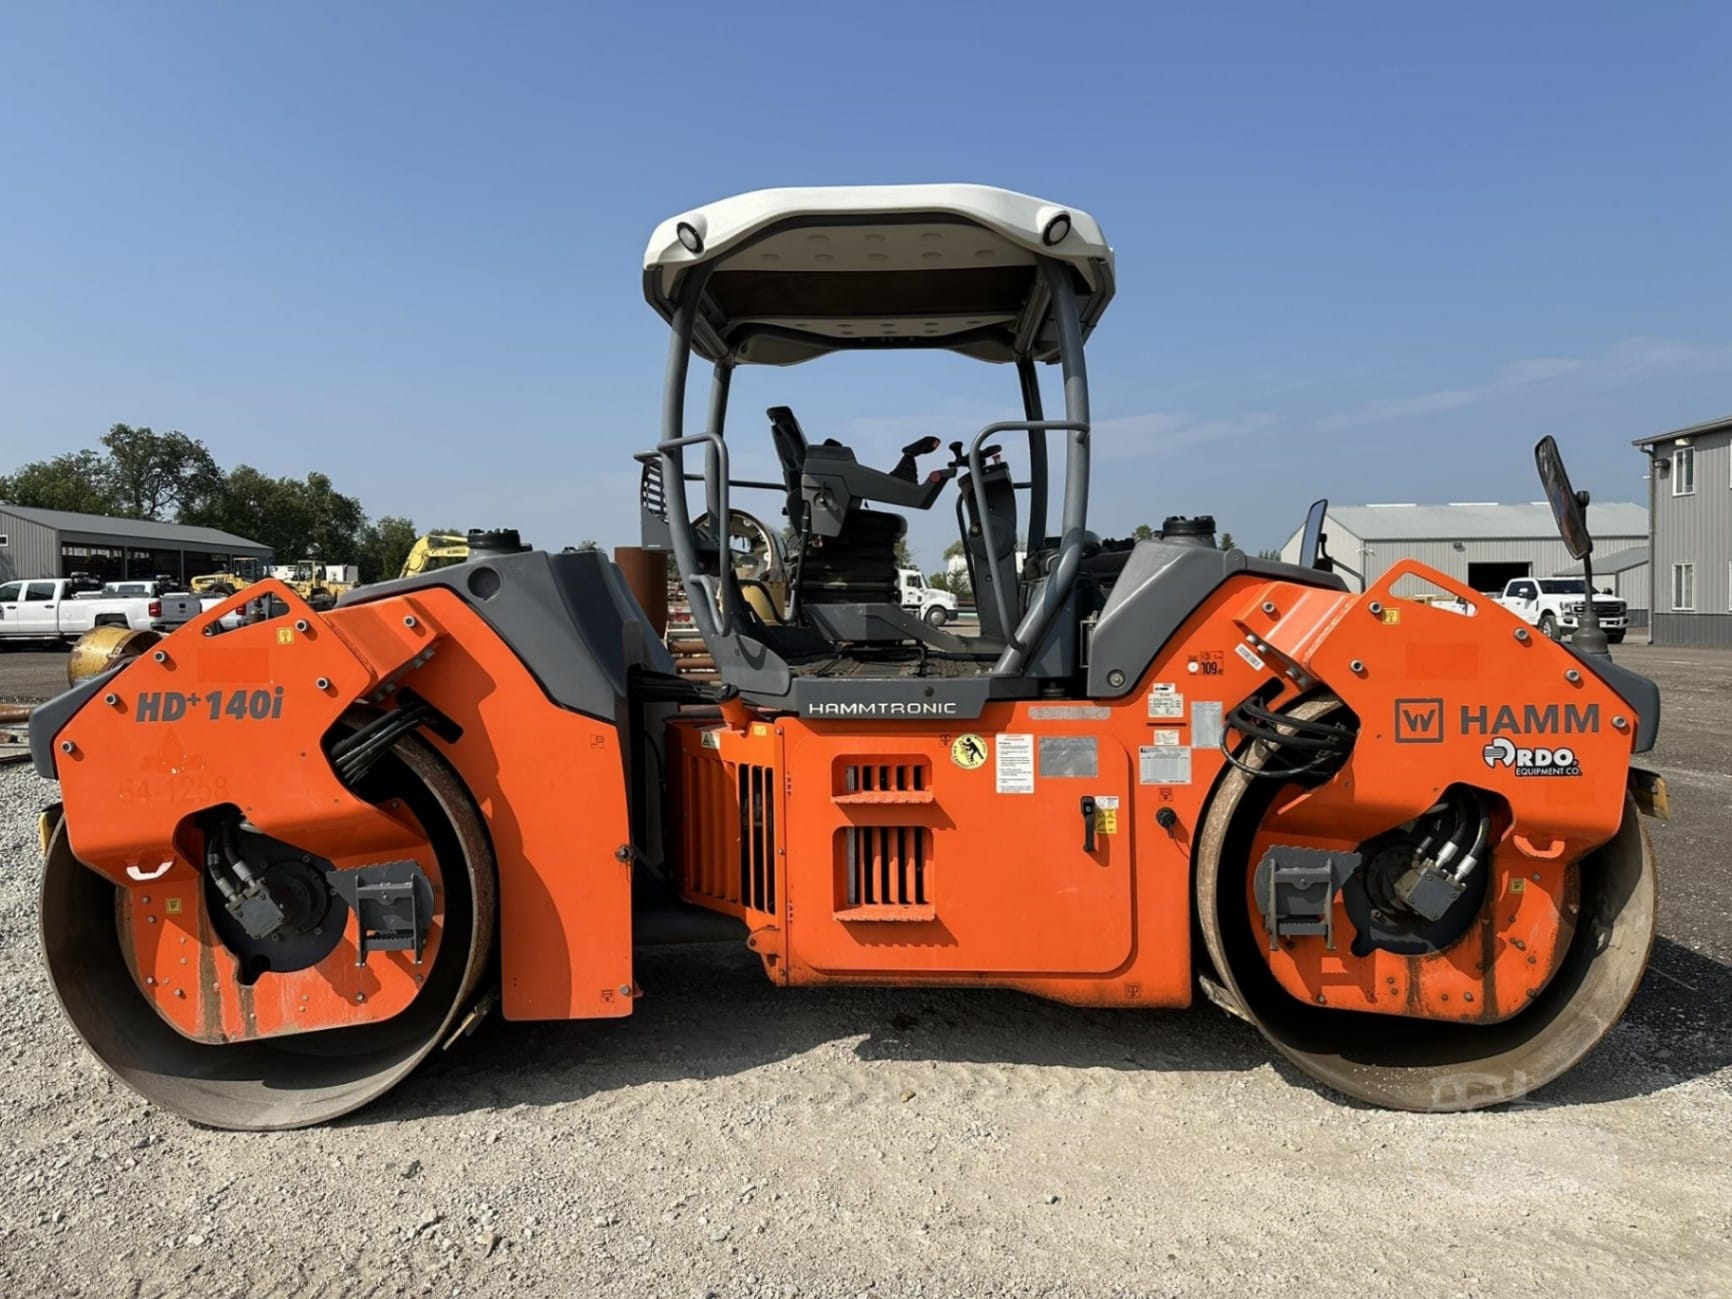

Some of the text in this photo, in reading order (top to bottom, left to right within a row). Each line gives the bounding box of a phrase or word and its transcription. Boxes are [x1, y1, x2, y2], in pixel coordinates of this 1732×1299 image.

[1201, 661, 1217, 675] 109
[205, 686, 284, 721] 140i
[808, 702, 957, 715] HAMMTRONIC
[1460, 703, 1600, 735] HAMM
[1516, 767, 1564, 776] EQUIPMENT
